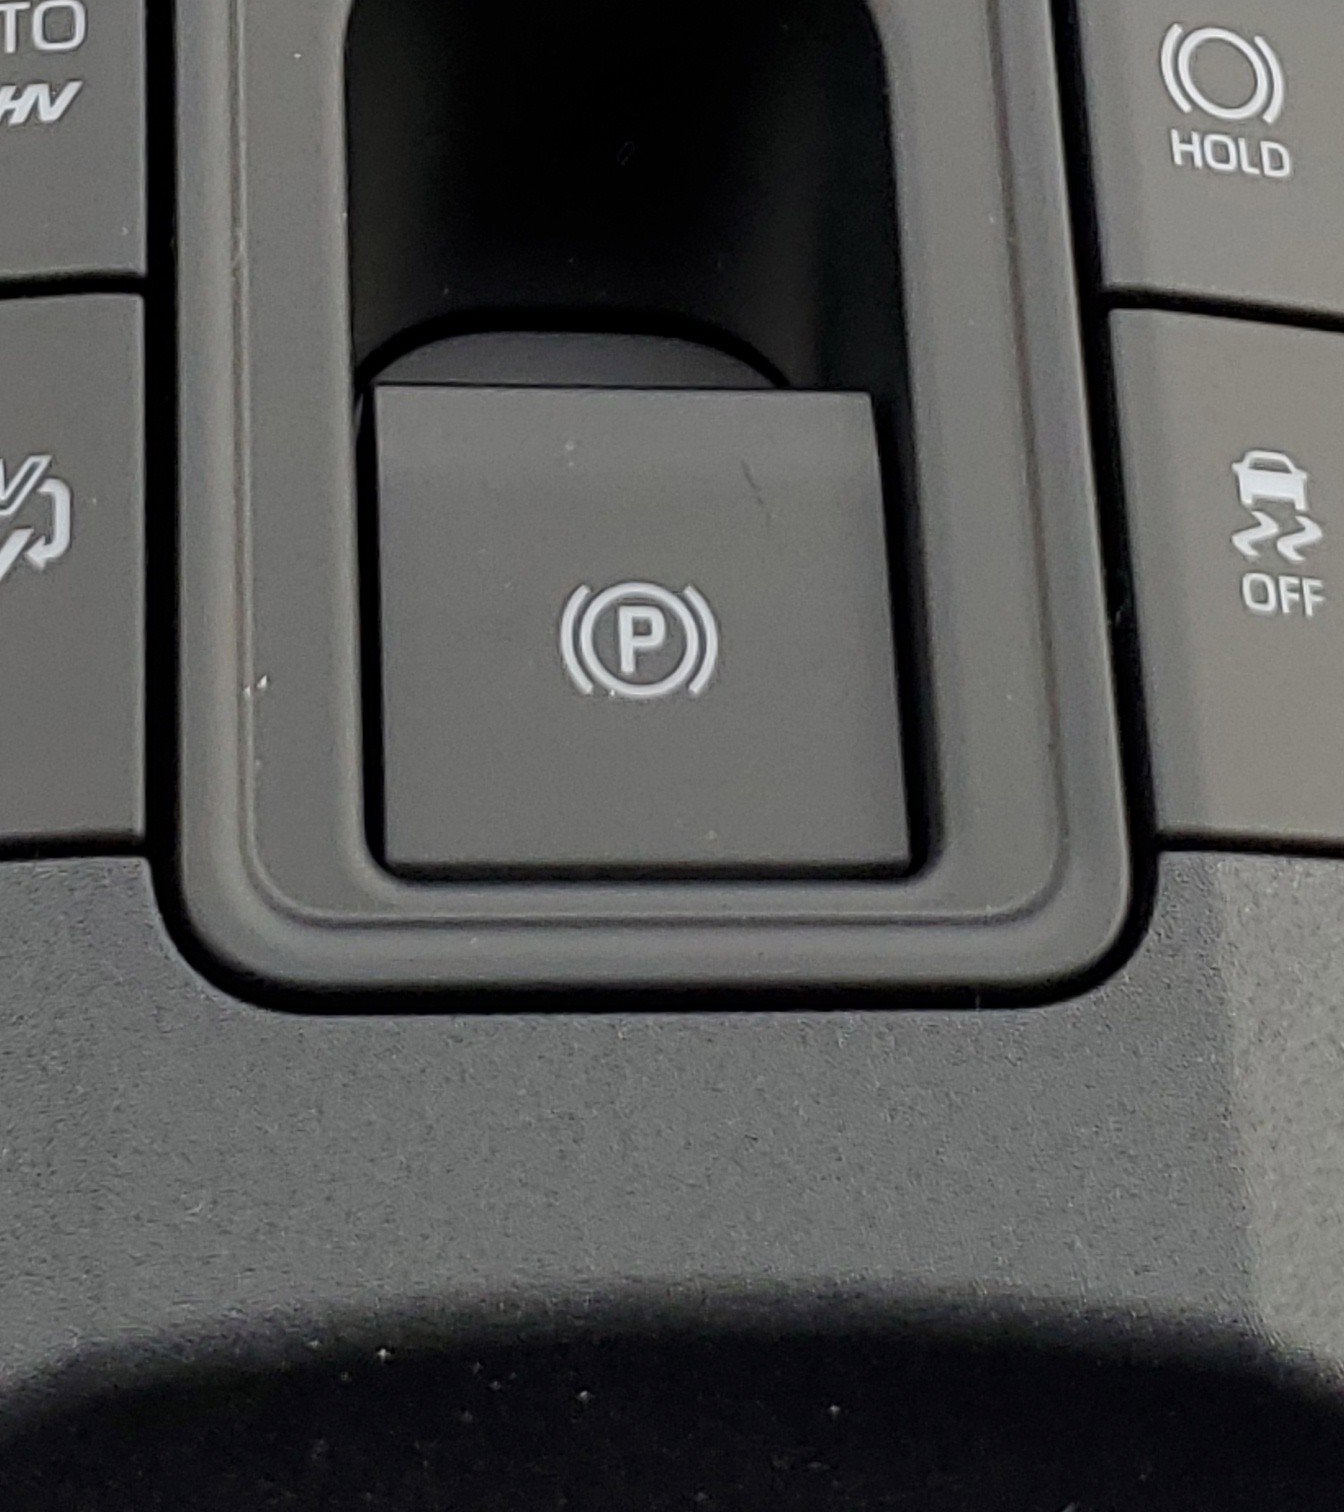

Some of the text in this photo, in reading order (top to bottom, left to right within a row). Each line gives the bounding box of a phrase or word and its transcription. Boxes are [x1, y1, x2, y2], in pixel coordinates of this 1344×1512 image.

[1170, 128, 1291, 177] HOLD
[1242, 572, 1326, 617] OFF
[619, 604, 666, 674] P
